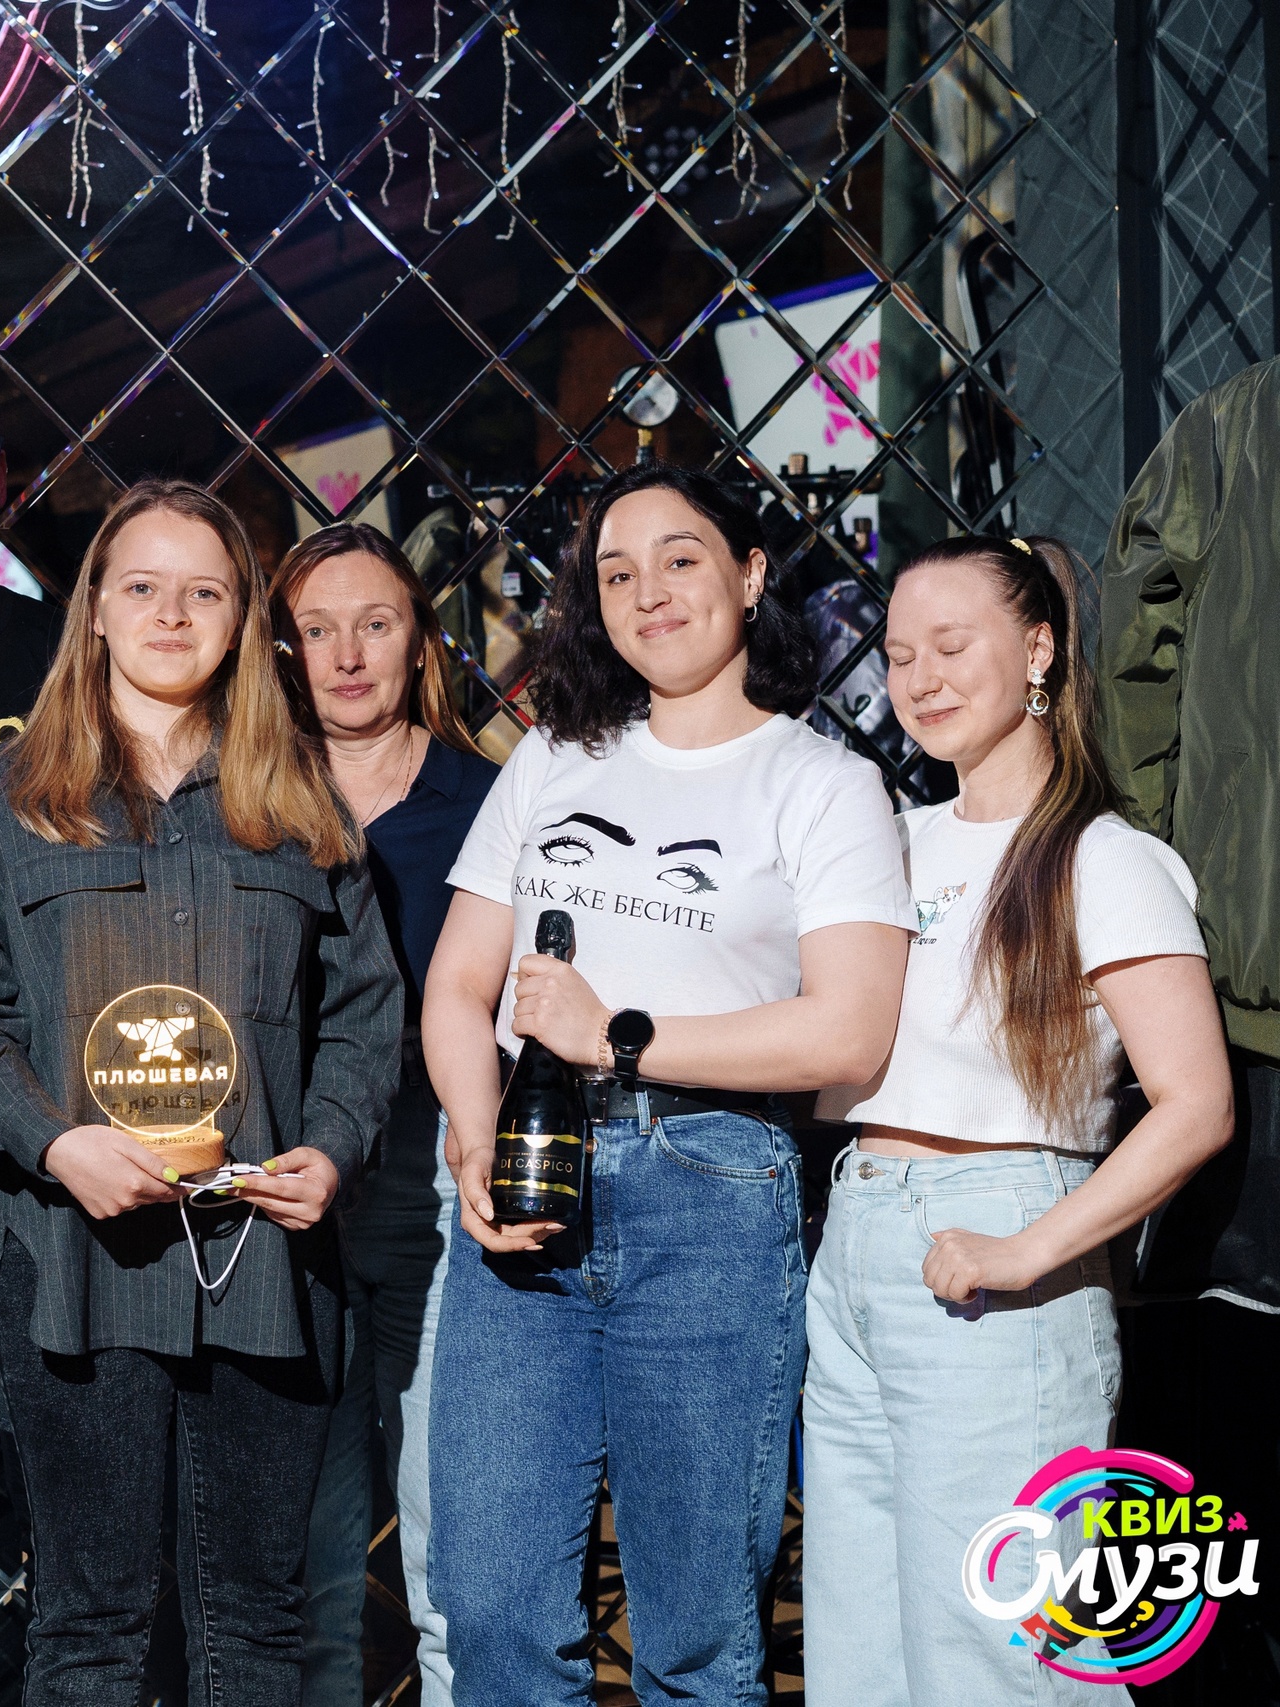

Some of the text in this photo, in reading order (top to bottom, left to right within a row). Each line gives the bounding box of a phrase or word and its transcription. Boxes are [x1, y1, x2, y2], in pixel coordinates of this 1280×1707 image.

[515, 875, 715, 933] КАК ЖЕ БЕСИТЕ
[93, 1066, 228, 1085] ПЛЮШЕВАЯ
[500, 1158, 573, 1173] DI CASPICO
